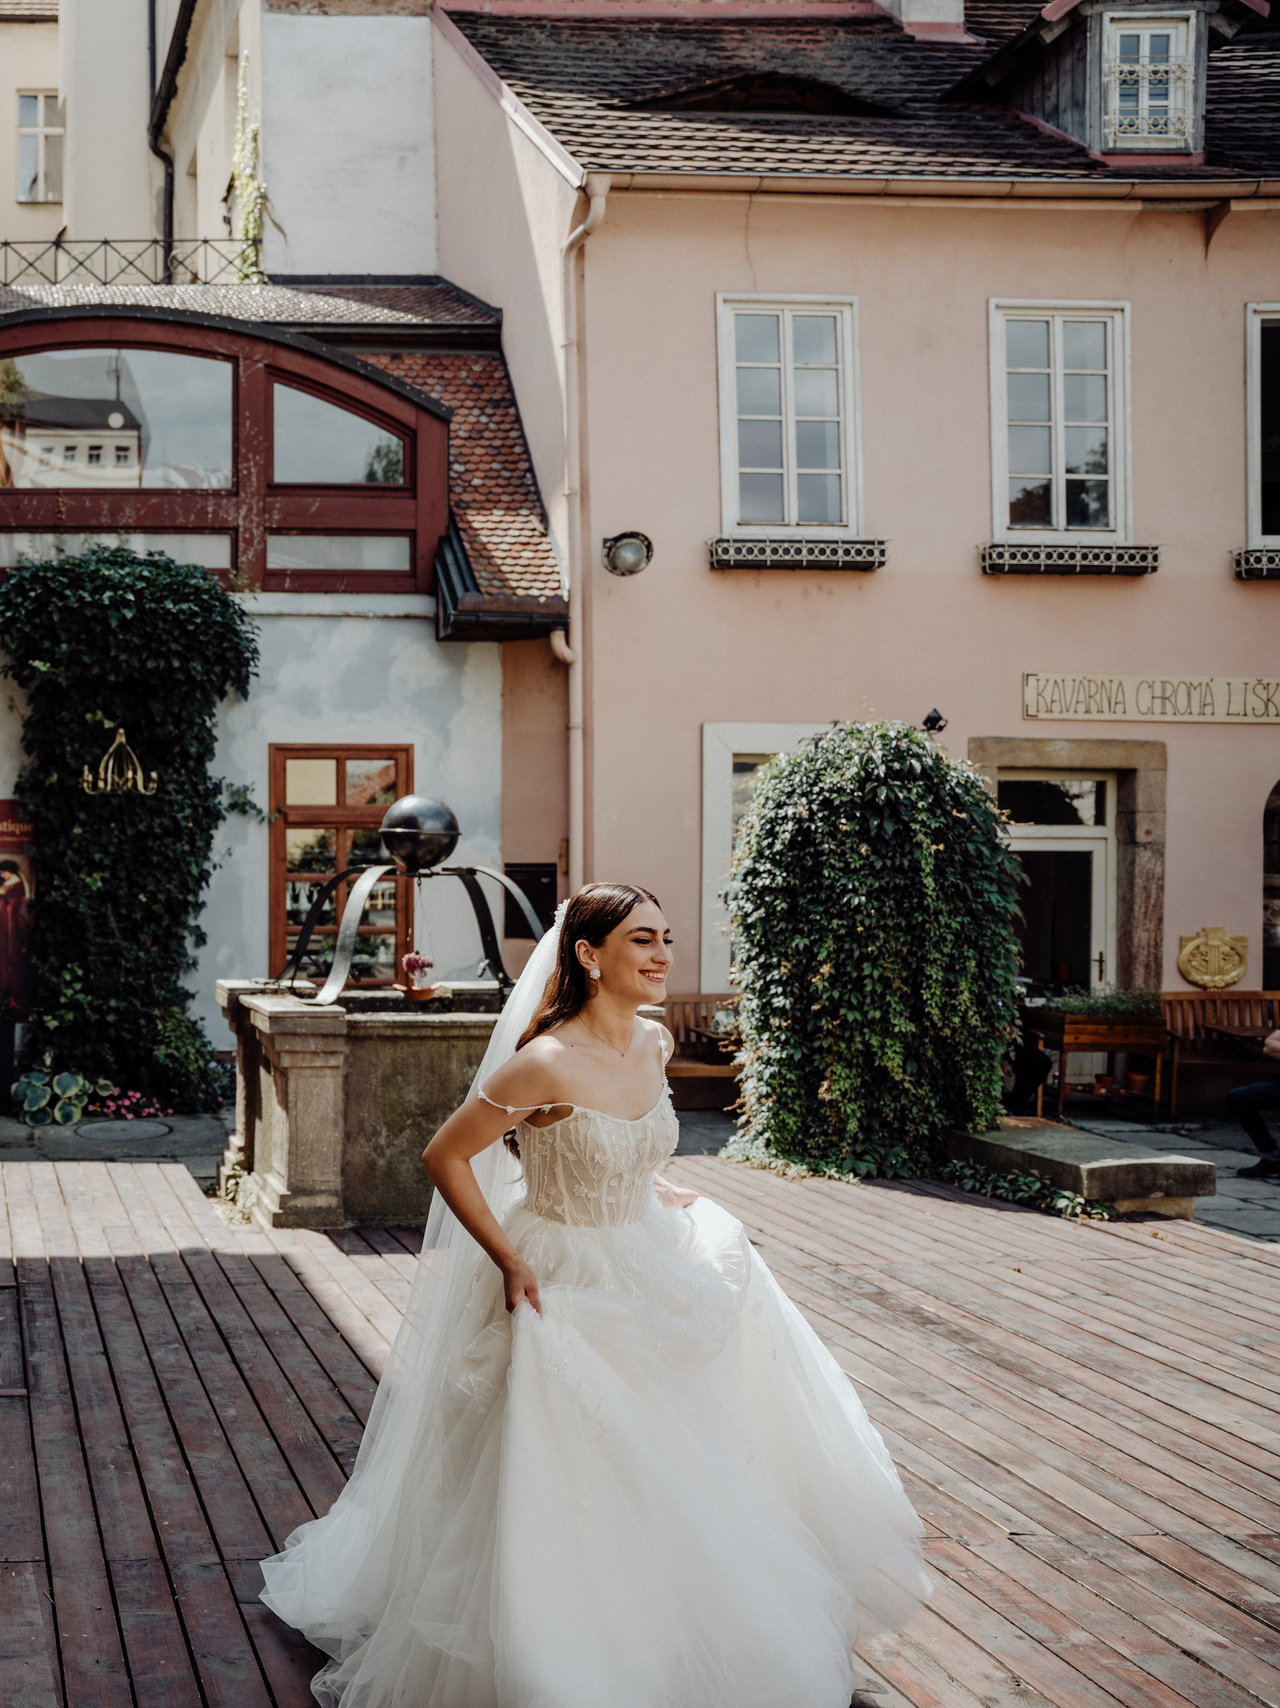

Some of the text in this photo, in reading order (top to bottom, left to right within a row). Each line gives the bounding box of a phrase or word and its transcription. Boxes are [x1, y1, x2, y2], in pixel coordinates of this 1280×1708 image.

[1034, 676, 1280, 718] KAVÁRNA CHROMÁ LIŠK
